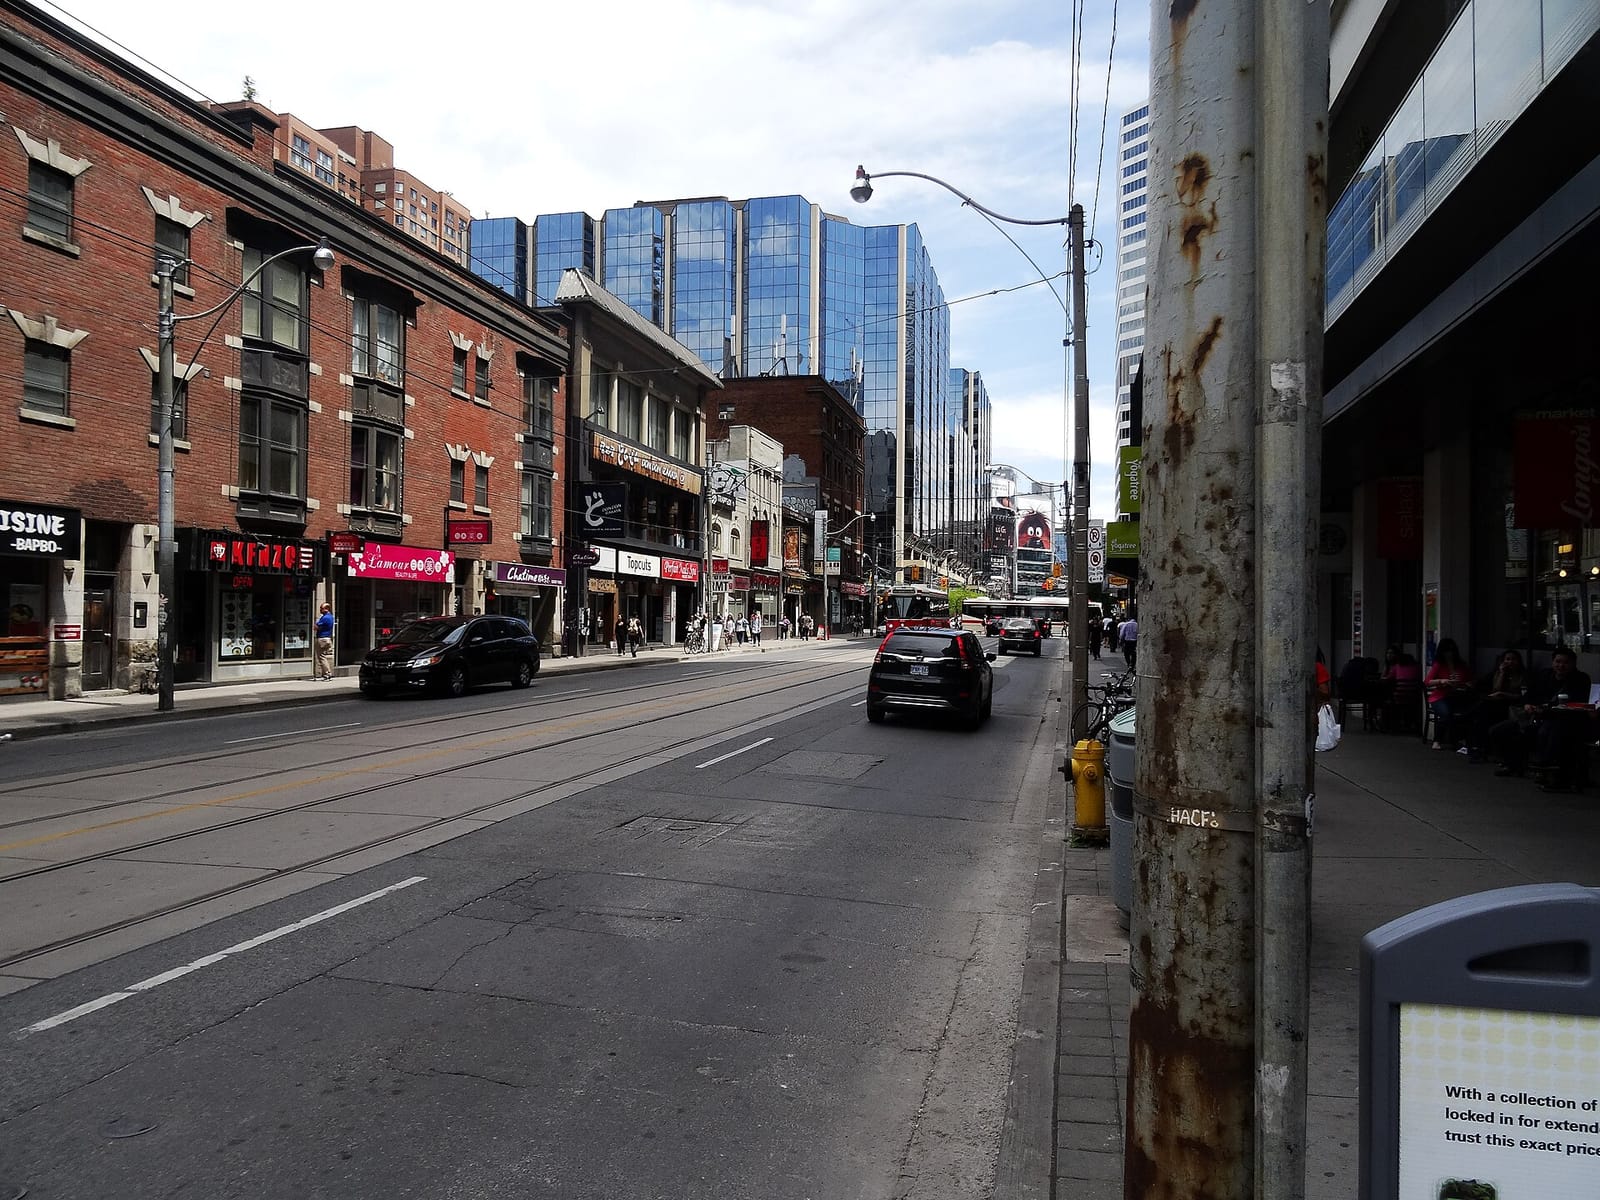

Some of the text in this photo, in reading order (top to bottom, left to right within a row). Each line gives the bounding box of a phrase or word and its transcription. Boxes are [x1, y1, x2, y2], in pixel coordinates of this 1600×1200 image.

[1126, 458, 1141, 501] Yogatree
[1399, 485, 1416, 539] salad
[507, 567, 538, 582] Chatime
[627, 555, 652, 573] Topcuts
[1445, 1085, 1598, 1111] With a collection of
[1445, 1107, 1600, 1134] locked in for extend
[1445, 1130, 1482, 1144] trust
[1486, 1134, 1515, 1147] this
[1519, 1139, 1562, 1152] exact
